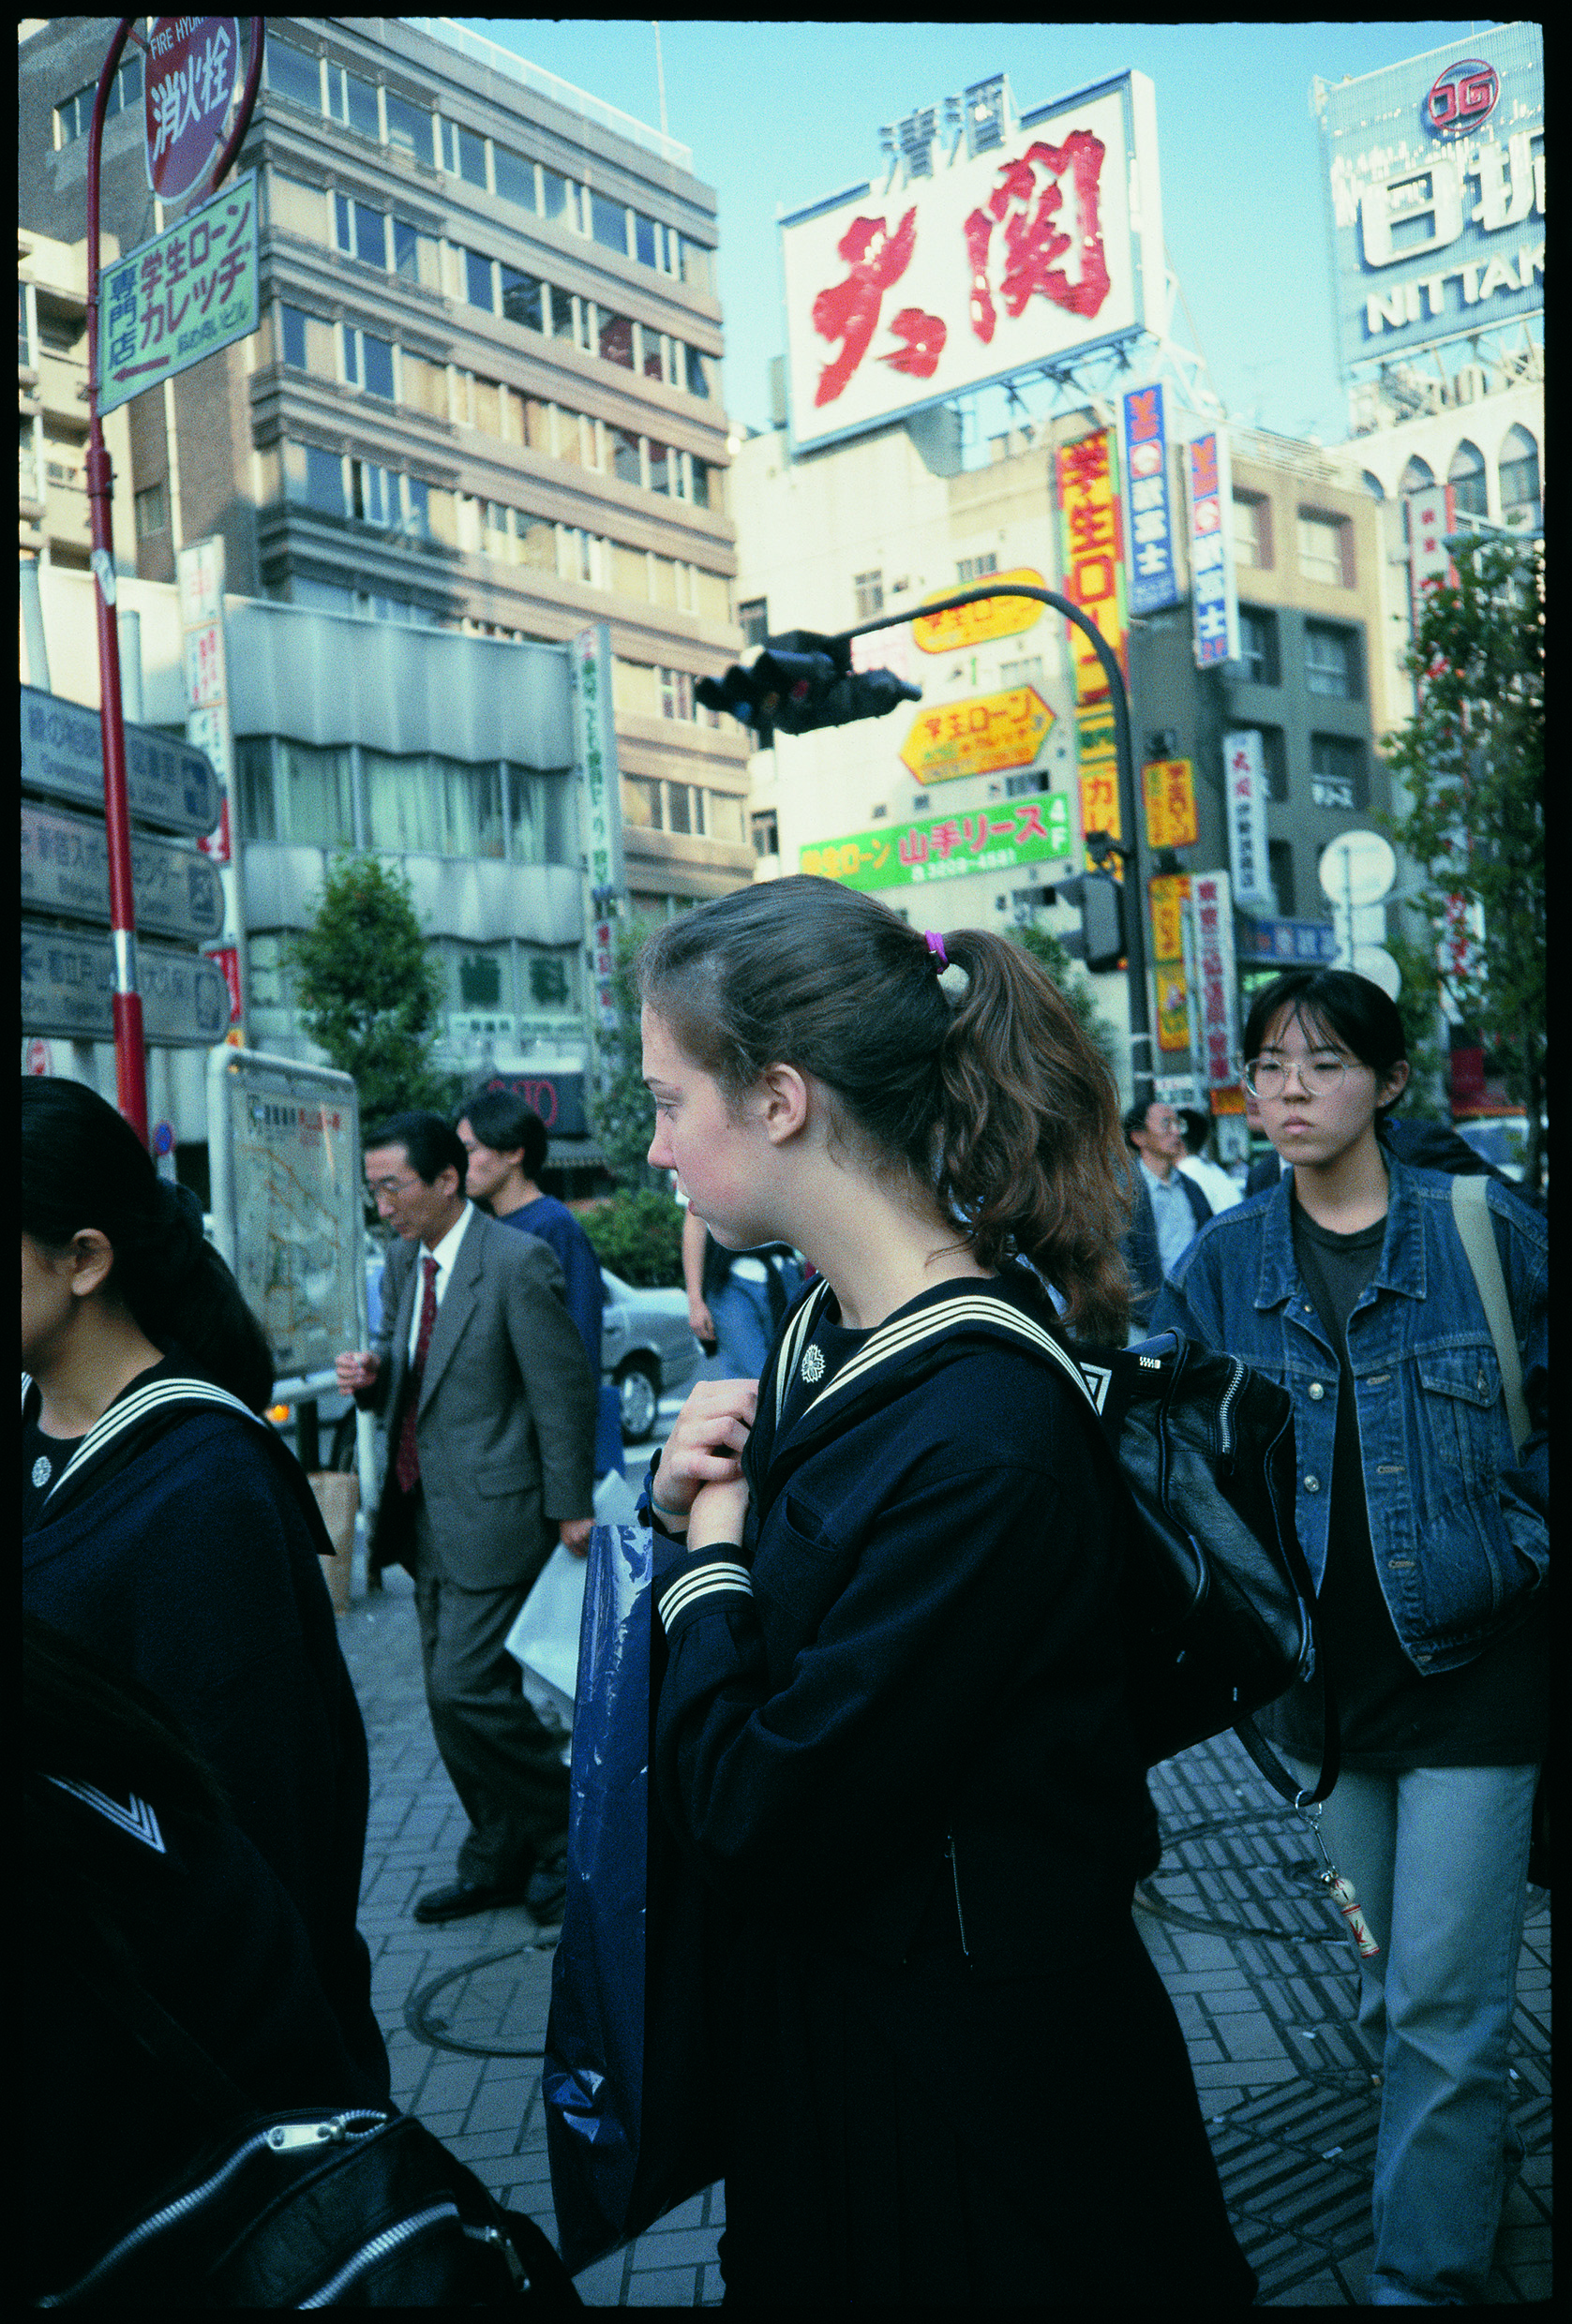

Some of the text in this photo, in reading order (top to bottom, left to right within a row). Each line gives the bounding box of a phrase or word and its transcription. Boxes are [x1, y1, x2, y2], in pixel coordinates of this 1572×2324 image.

[150, 26, 175, 60] FIRE
[151, 25, 231, 162] 消火栓
[141, 201, 251, 300] 学生ローン
[898, 804, 1049, 867] 山手リース
